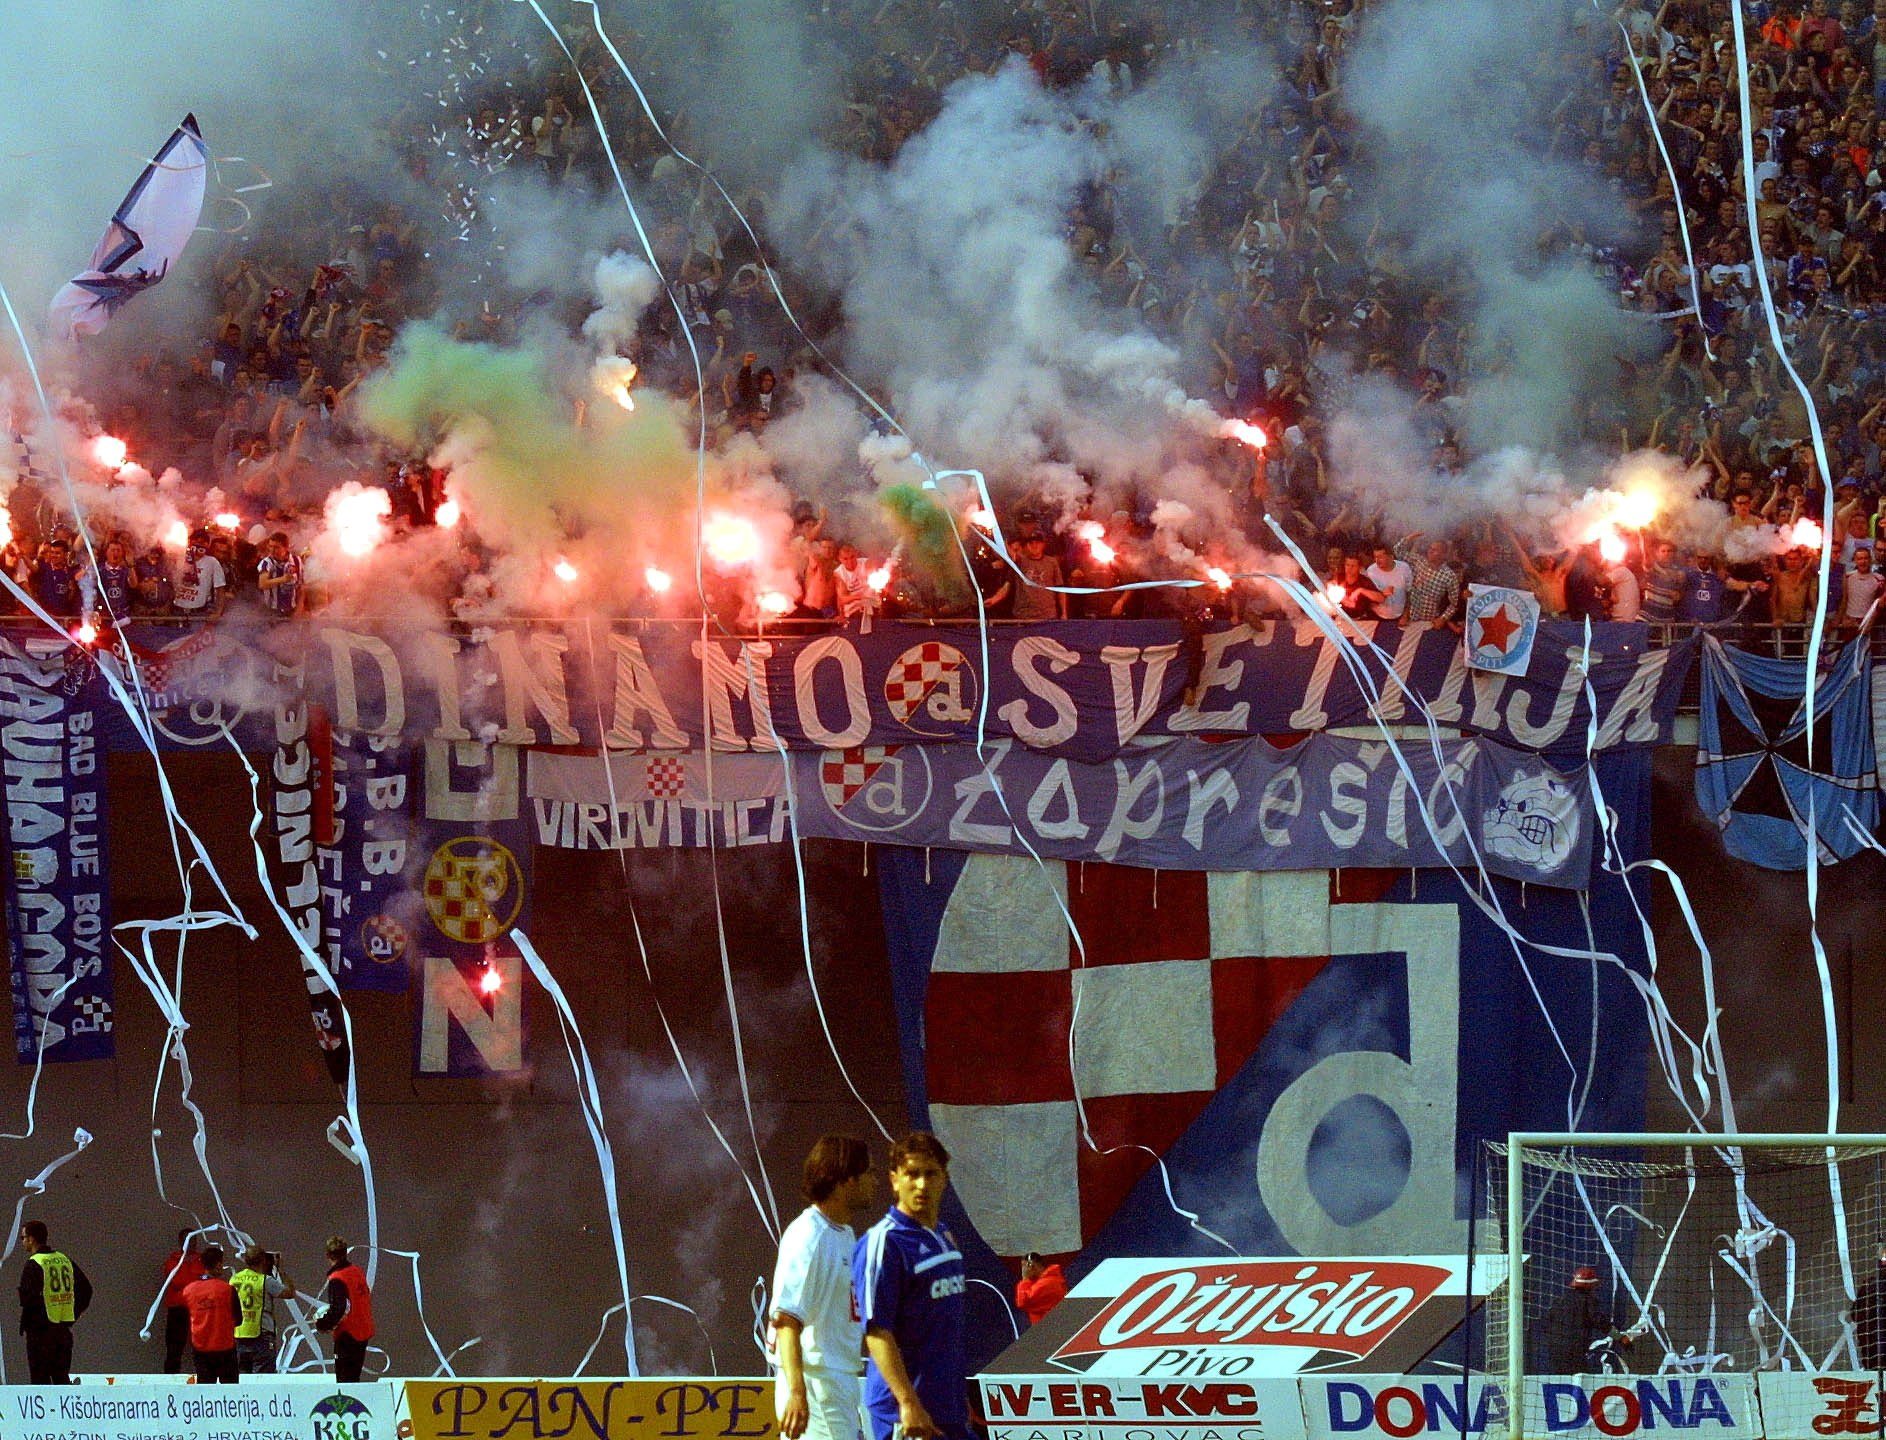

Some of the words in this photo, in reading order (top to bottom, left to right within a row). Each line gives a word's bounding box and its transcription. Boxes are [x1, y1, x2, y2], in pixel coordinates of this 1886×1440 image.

[321, 628, 873, 752] DINAMO
[68, 711, 95, 777] BAD
[533, 796, 798, 851] VIROVITICA
[948, 739, 1481, 862] Zaprešić
[69, 791, 98, 879] BLUE
[71, 893, 102, 978] BOYS
[49, 1265, 71, 1293] 86
[1099, 1266, 1415, 1345] Ožujsko
[1139, 1348, 1256, 1377] Pivo
[17, 1394, 46, 1420] VIS
[60, 1394, 160, 1420] Kišobranarna
[167, 1393, 178, 1418] &
[182, 1394, 265, 1425] galanterija,
[269, 1394, 297, 1419] d.d.
[313, 1420, 371, 1440] K&G
[1326, 1381, 1510, 1438] DONA
[1541, 1378, 1736, 1437] DONA
